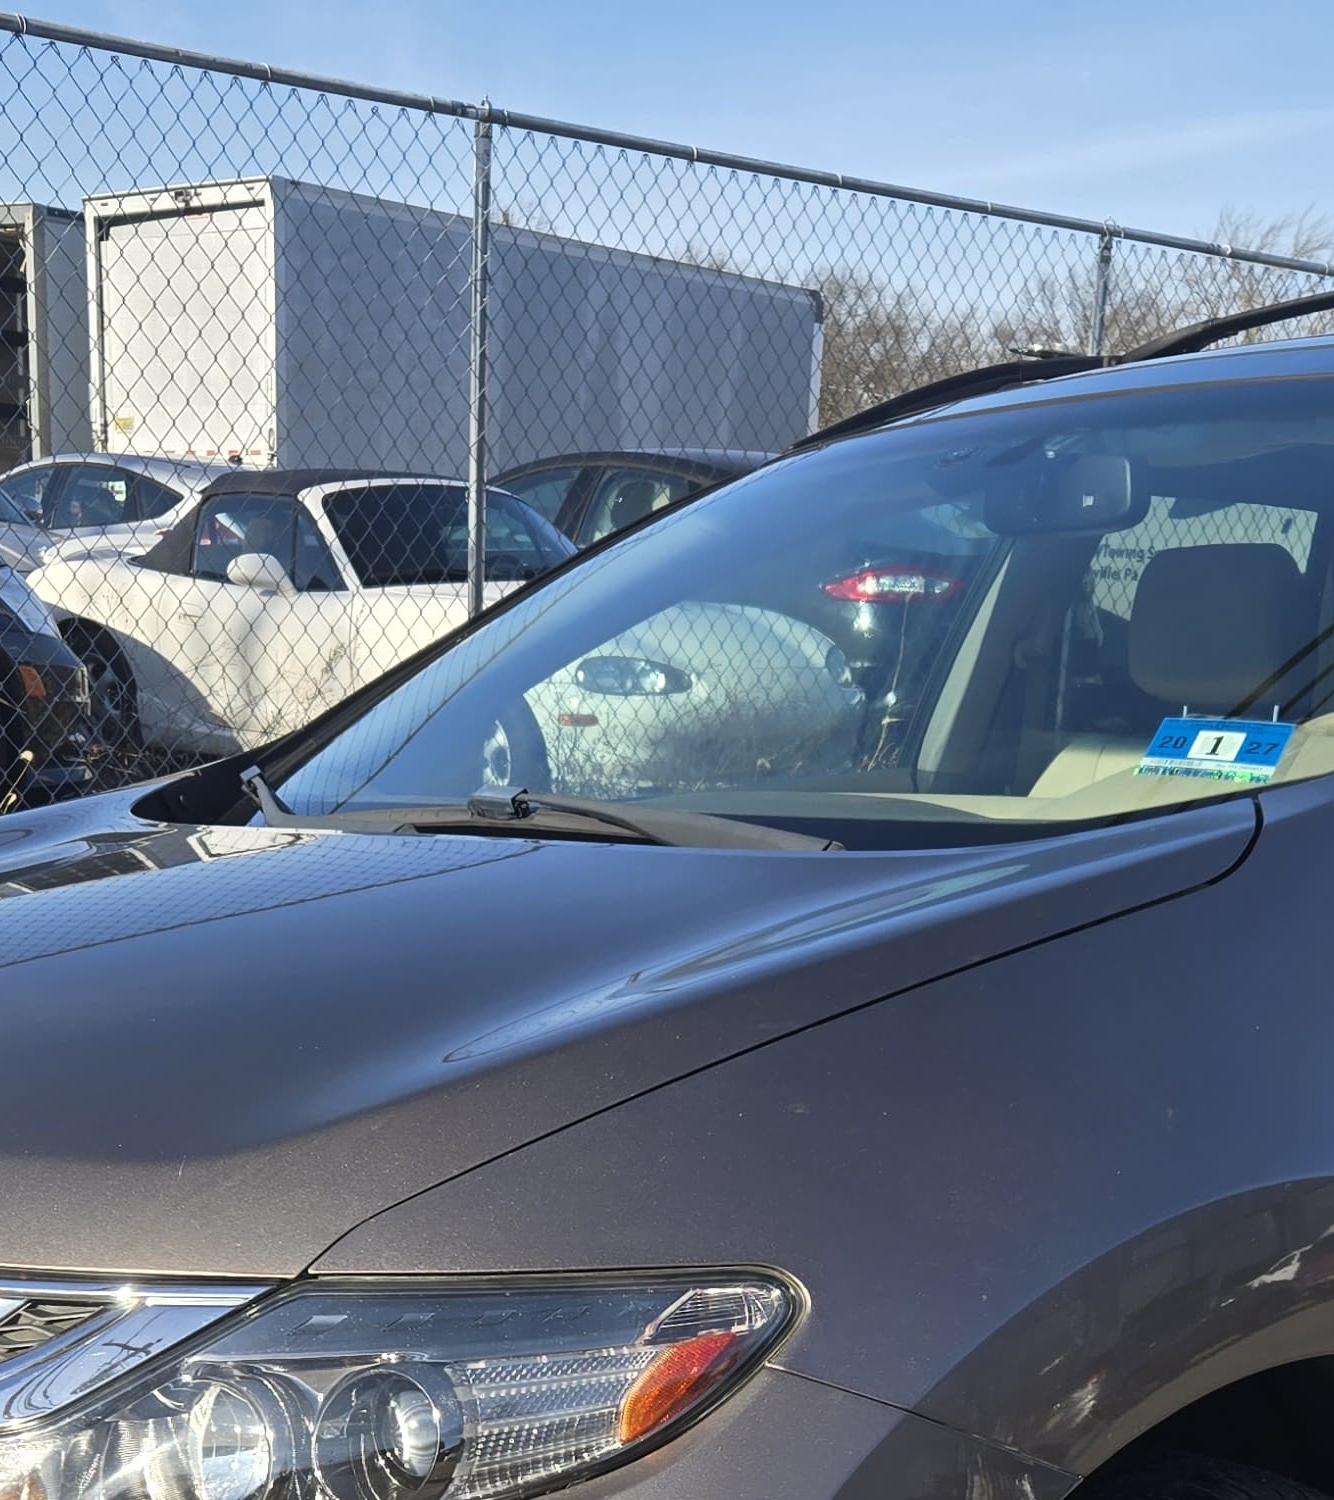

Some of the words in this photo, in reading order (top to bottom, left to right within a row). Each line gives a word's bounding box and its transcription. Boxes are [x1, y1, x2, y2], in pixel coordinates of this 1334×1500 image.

[1158, 735, 1187, 749] 20
[1205, 735, 1224, 756] 1
[1242, 741, 1280, 755] 27
